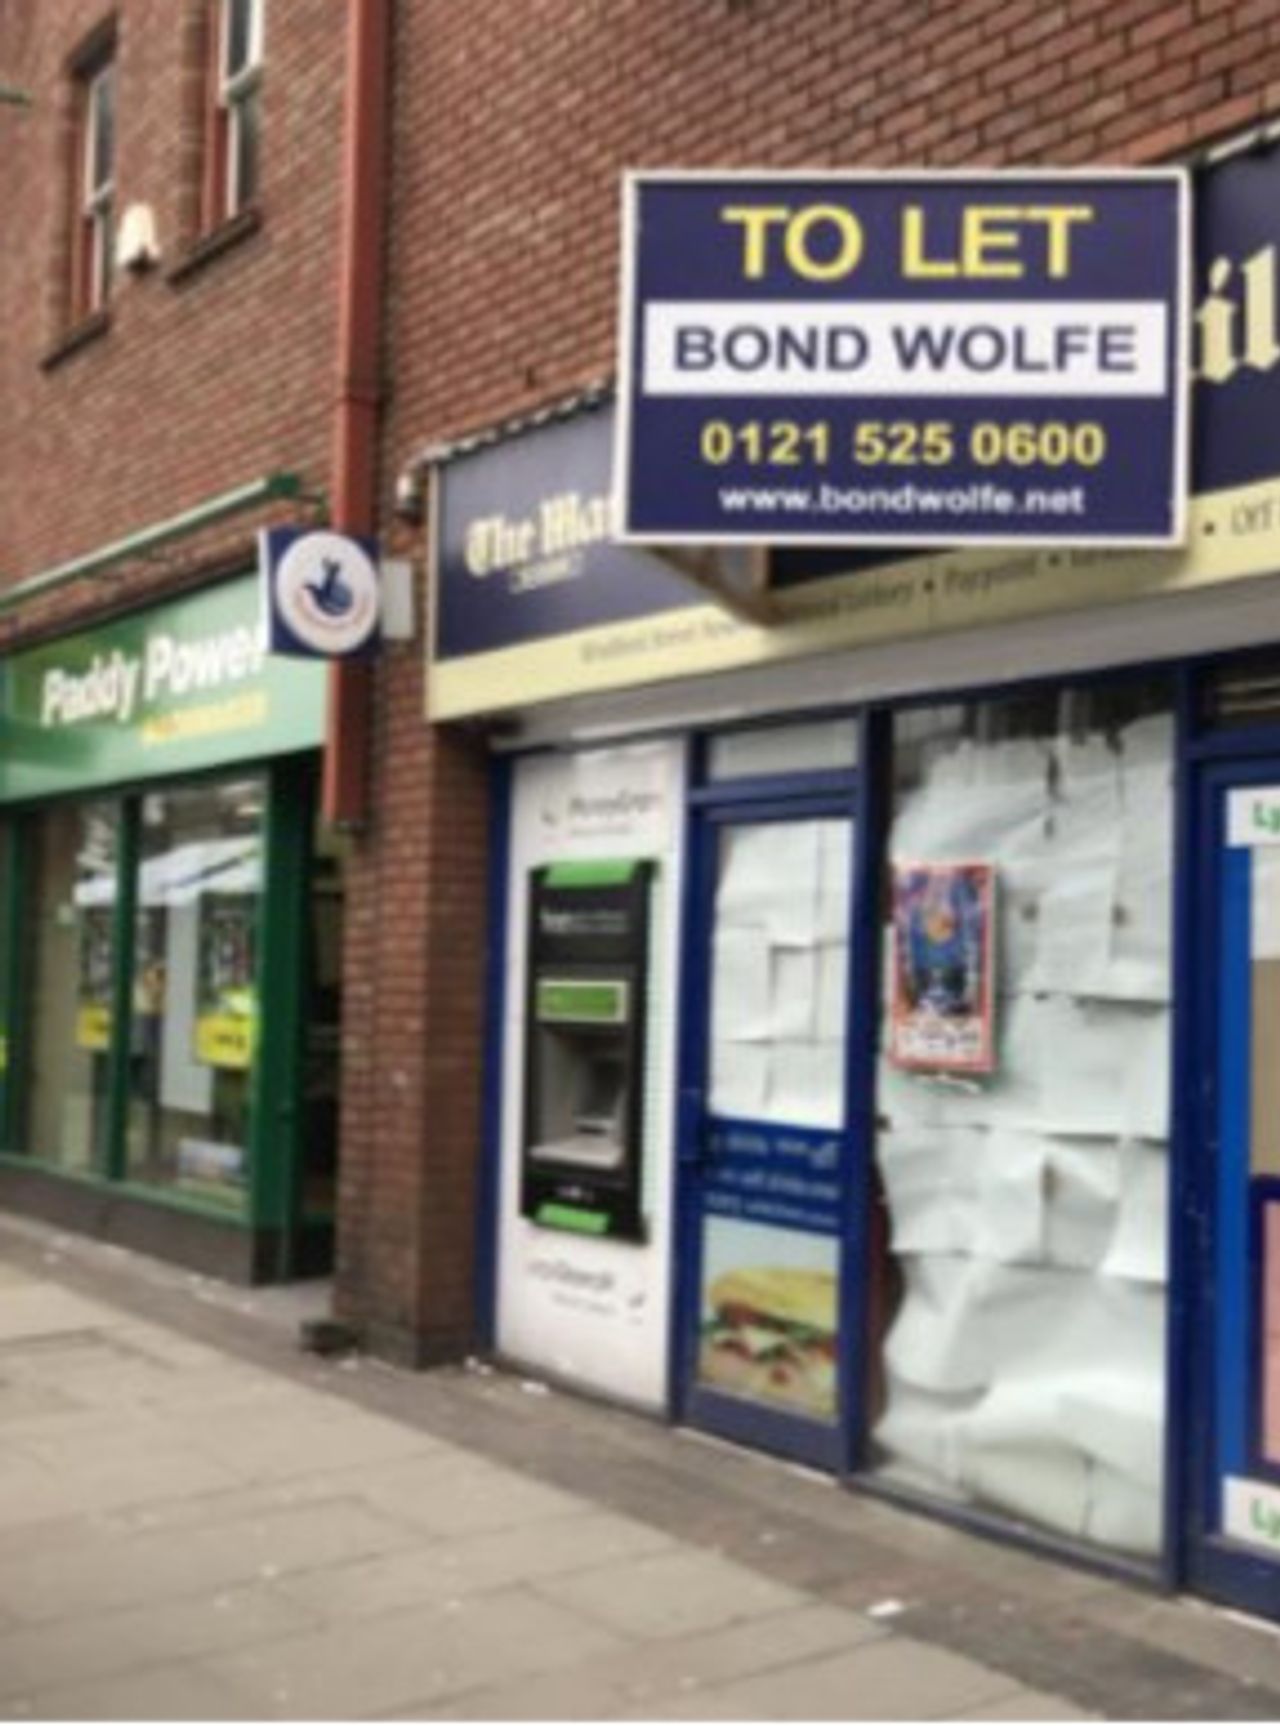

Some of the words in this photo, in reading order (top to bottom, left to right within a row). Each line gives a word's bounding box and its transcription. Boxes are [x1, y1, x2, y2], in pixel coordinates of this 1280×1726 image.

[721, 204, 864, 281] TO
[902, 205, 1094, 279] LET
[673, 324, 869, 373] BOND
[891, 323, 1138, 373] WOLFE
[701, 421, 830, 465] 0121
[853, 421, 954, 465] 525
[970, 421, 1107, 465] 0600
[718, 483, 1085, 516] www.bondwolfe.net
[41, 648, 138, 727] Paddy
